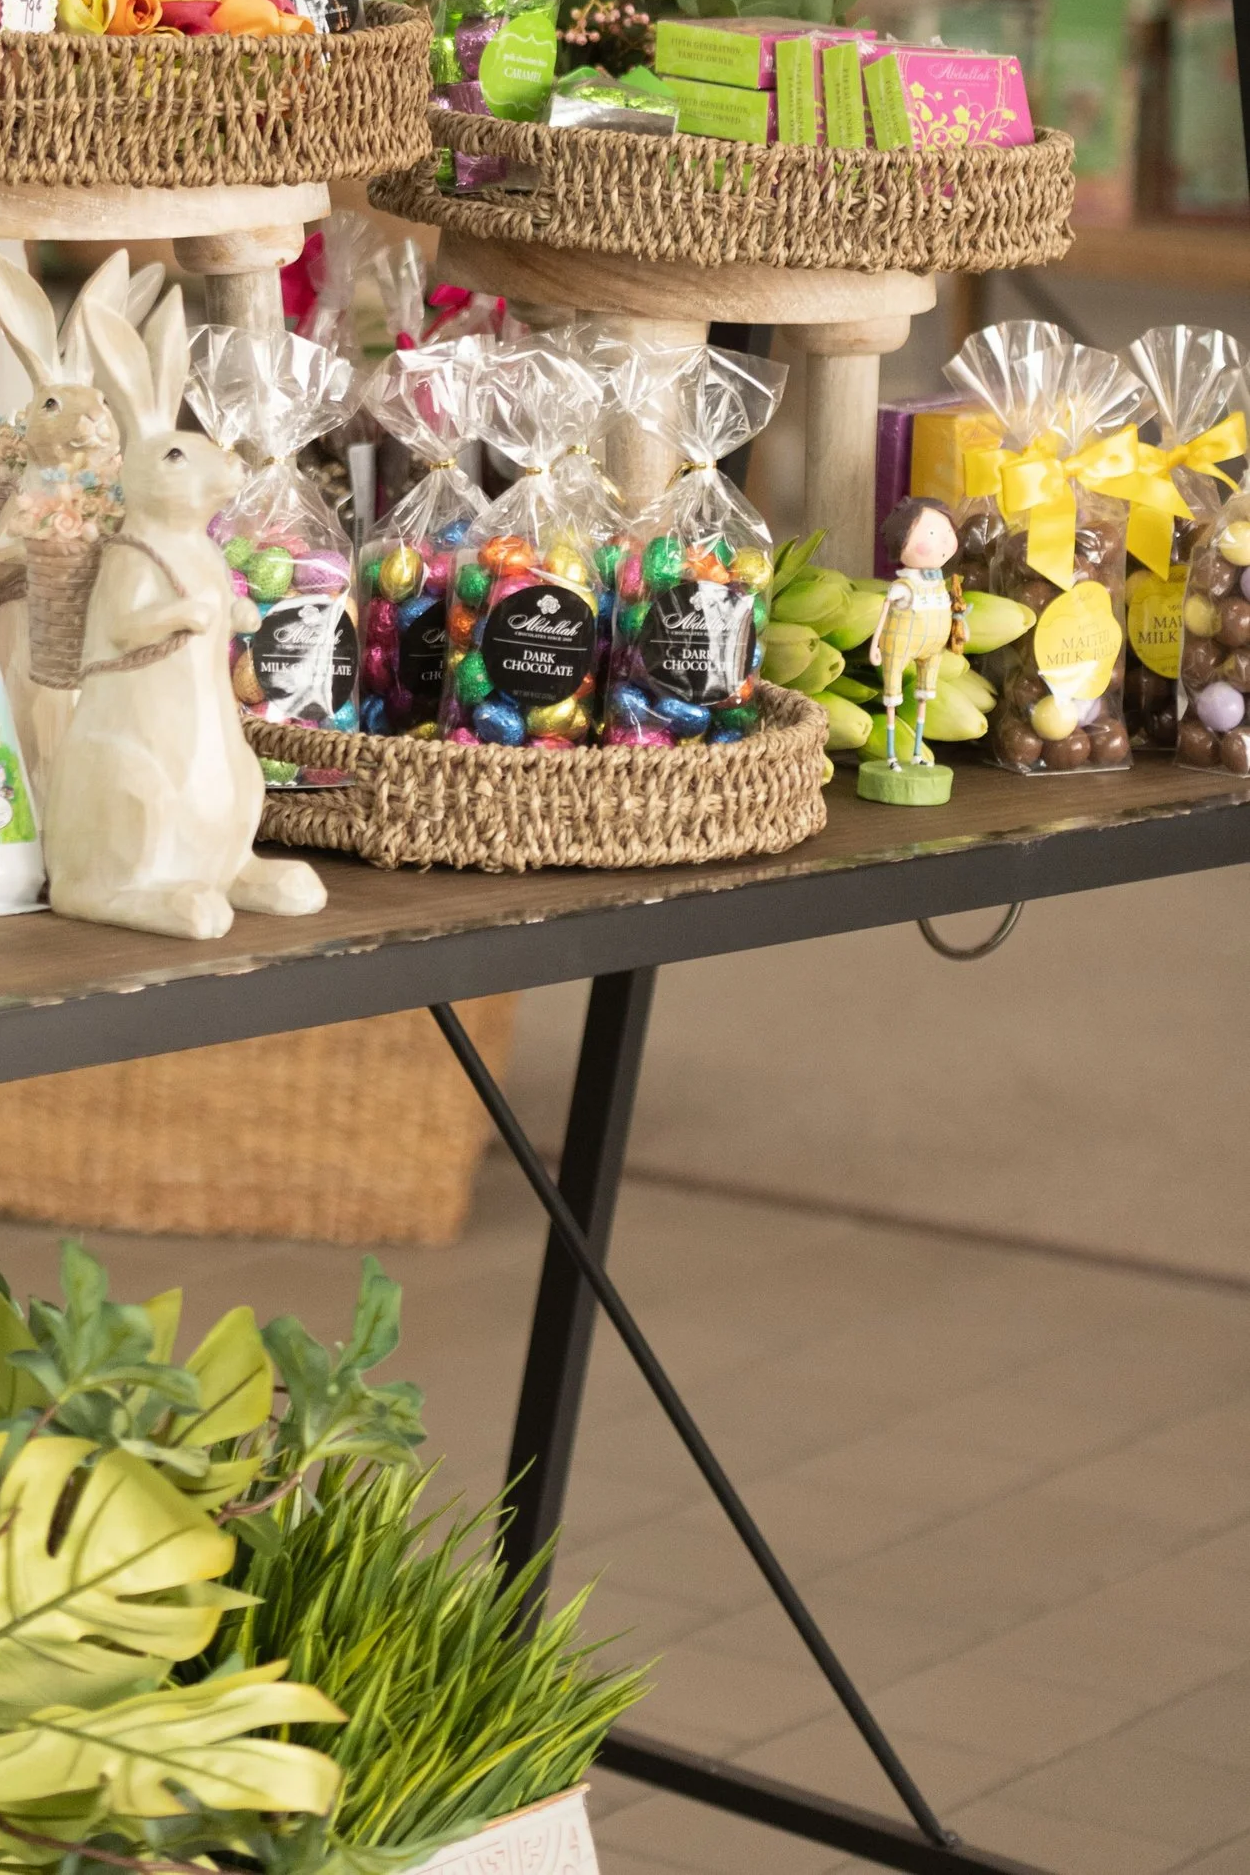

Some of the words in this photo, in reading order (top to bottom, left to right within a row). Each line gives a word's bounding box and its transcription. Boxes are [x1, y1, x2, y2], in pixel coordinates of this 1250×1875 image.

[503, 66, 543, 84] CARAMEL
[929, 62, 991, 81] Abdallah
[507, 614, 583, 636] Abdallah
[1138, 631, 1178, 645] MILK
[523, 650, 556, 663] DARK
[1045, 652, 1085, 667] MILK
[261, 661, 290, 673] MILK
[503, 659, 574, 677] CHOCOLATE
